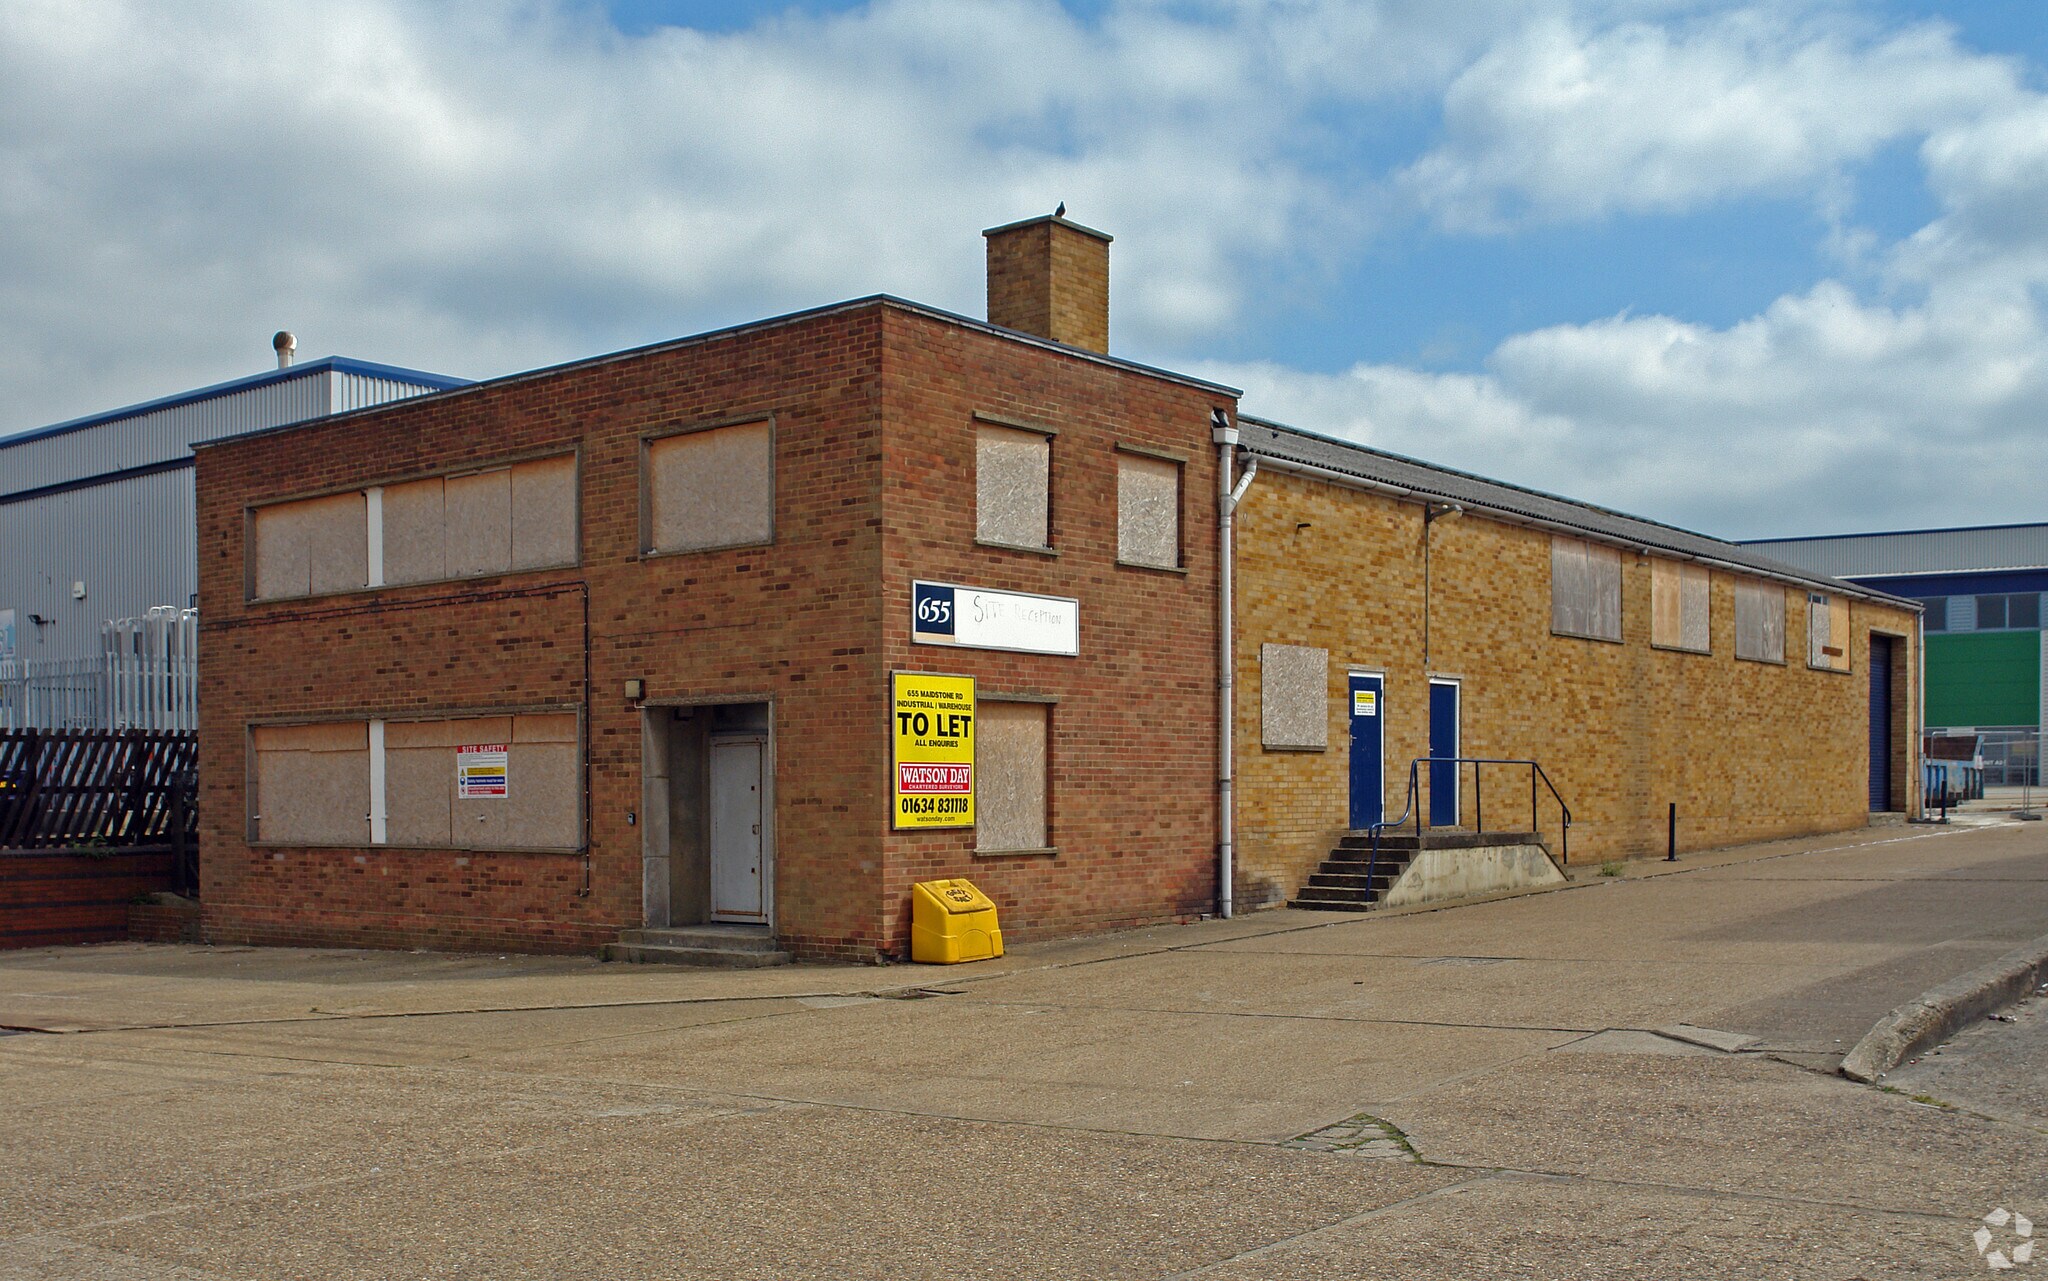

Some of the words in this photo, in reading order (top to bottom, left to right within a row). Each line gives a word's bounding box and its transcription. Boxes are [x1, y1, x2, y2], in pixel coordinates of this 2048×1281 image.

[918, 597, 951, 623] 655
[920, 690, 954, 699] MAIDSTONE
[955, 692, 963, 700] RD
[897, 700, 934, 709] INDUSTRIAL
[938, 702, 972, 711] WAREHOUSE
[897, 712, 929, 736] TO
[936, 713, 972, 738] LET
[915, 739, 927, 747] ALL
[928, 739, 958, 748] ENQUIRIES
[902, 767, 948, 784] WATSON
[949, 768, 970, 784] DAY
[901, 797, 934, 814] 01634
[937, 798, 968, 813] 831118
[916, 815, 955, 823] watsonday.com
